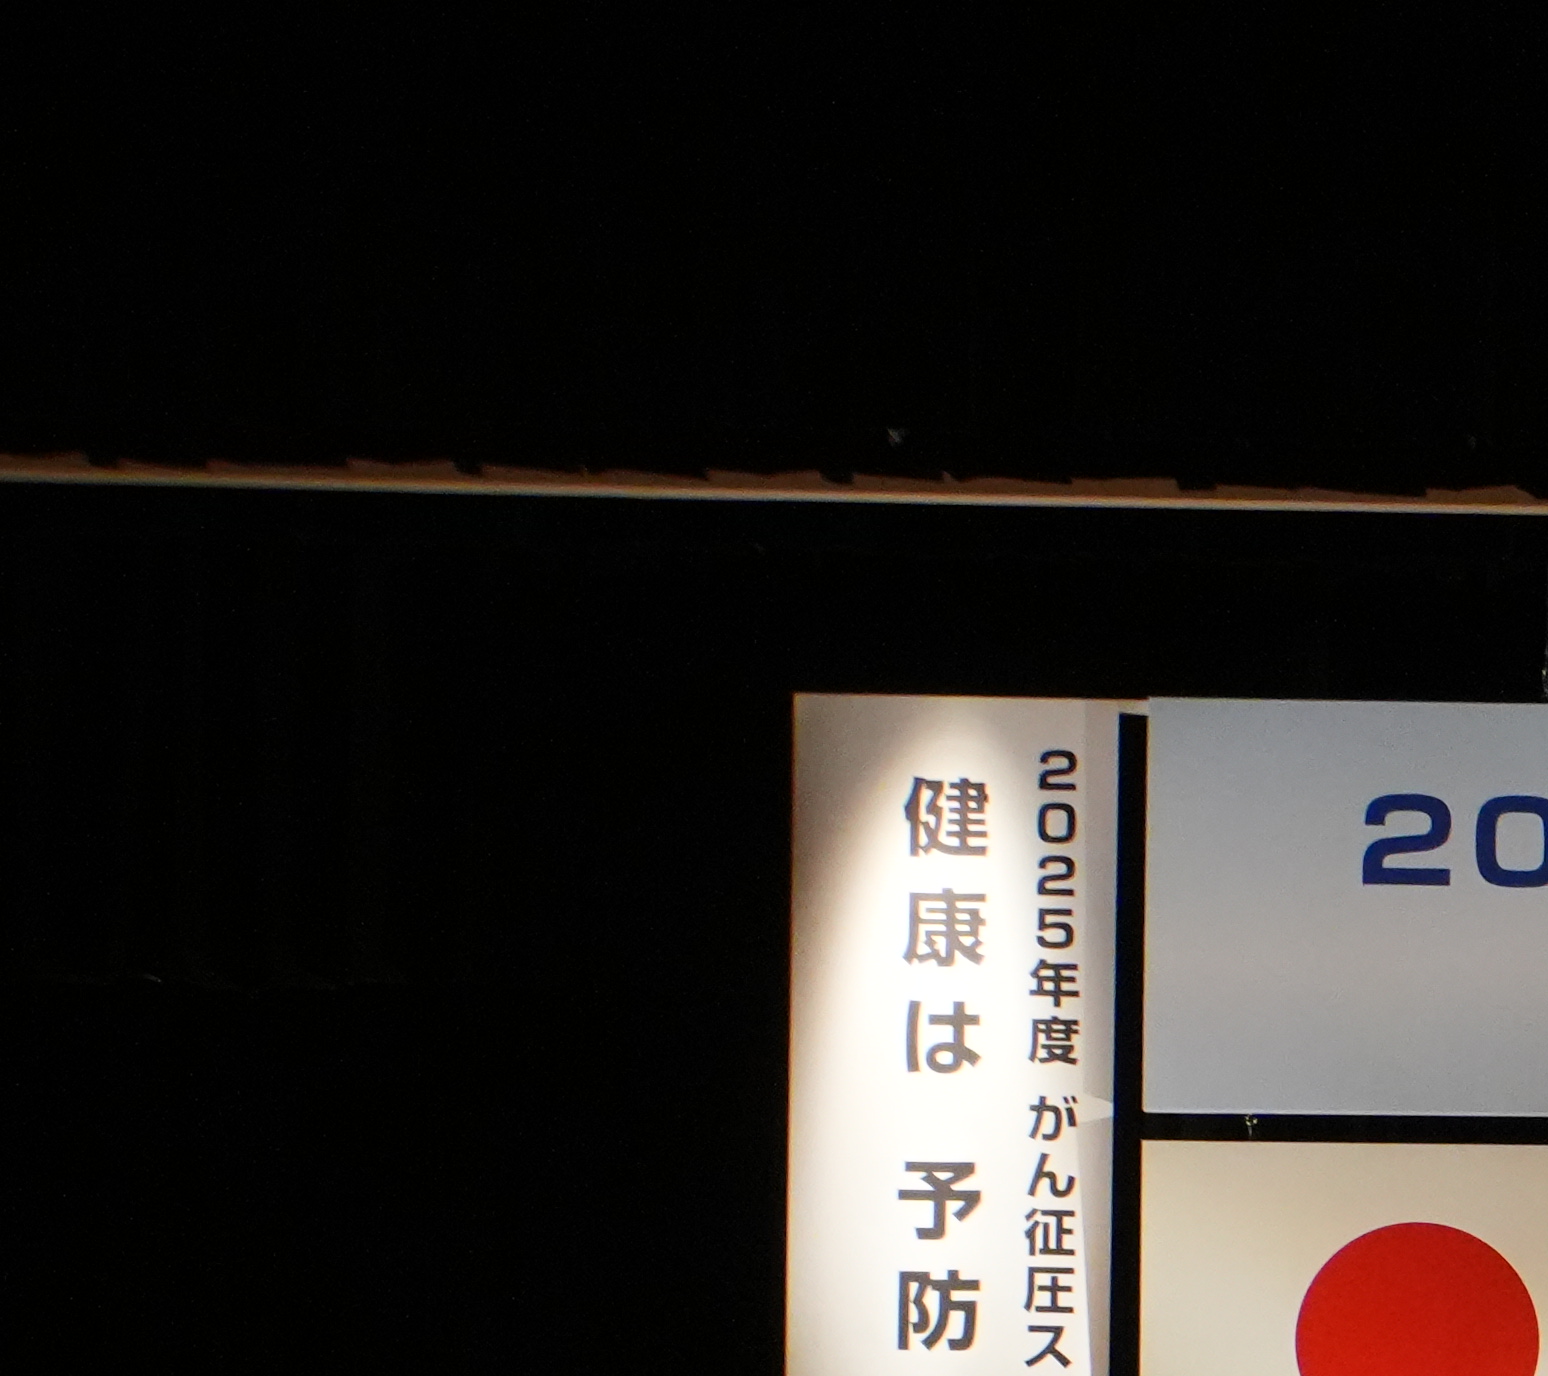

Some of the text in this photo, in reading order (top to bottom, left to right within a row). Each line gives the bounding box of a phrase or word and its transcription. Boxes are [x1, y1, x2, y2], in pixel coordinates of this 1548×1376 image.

[902, 775, 990, 1074] 健康は
[1028, 748, 1081, 1066] 2025年度
